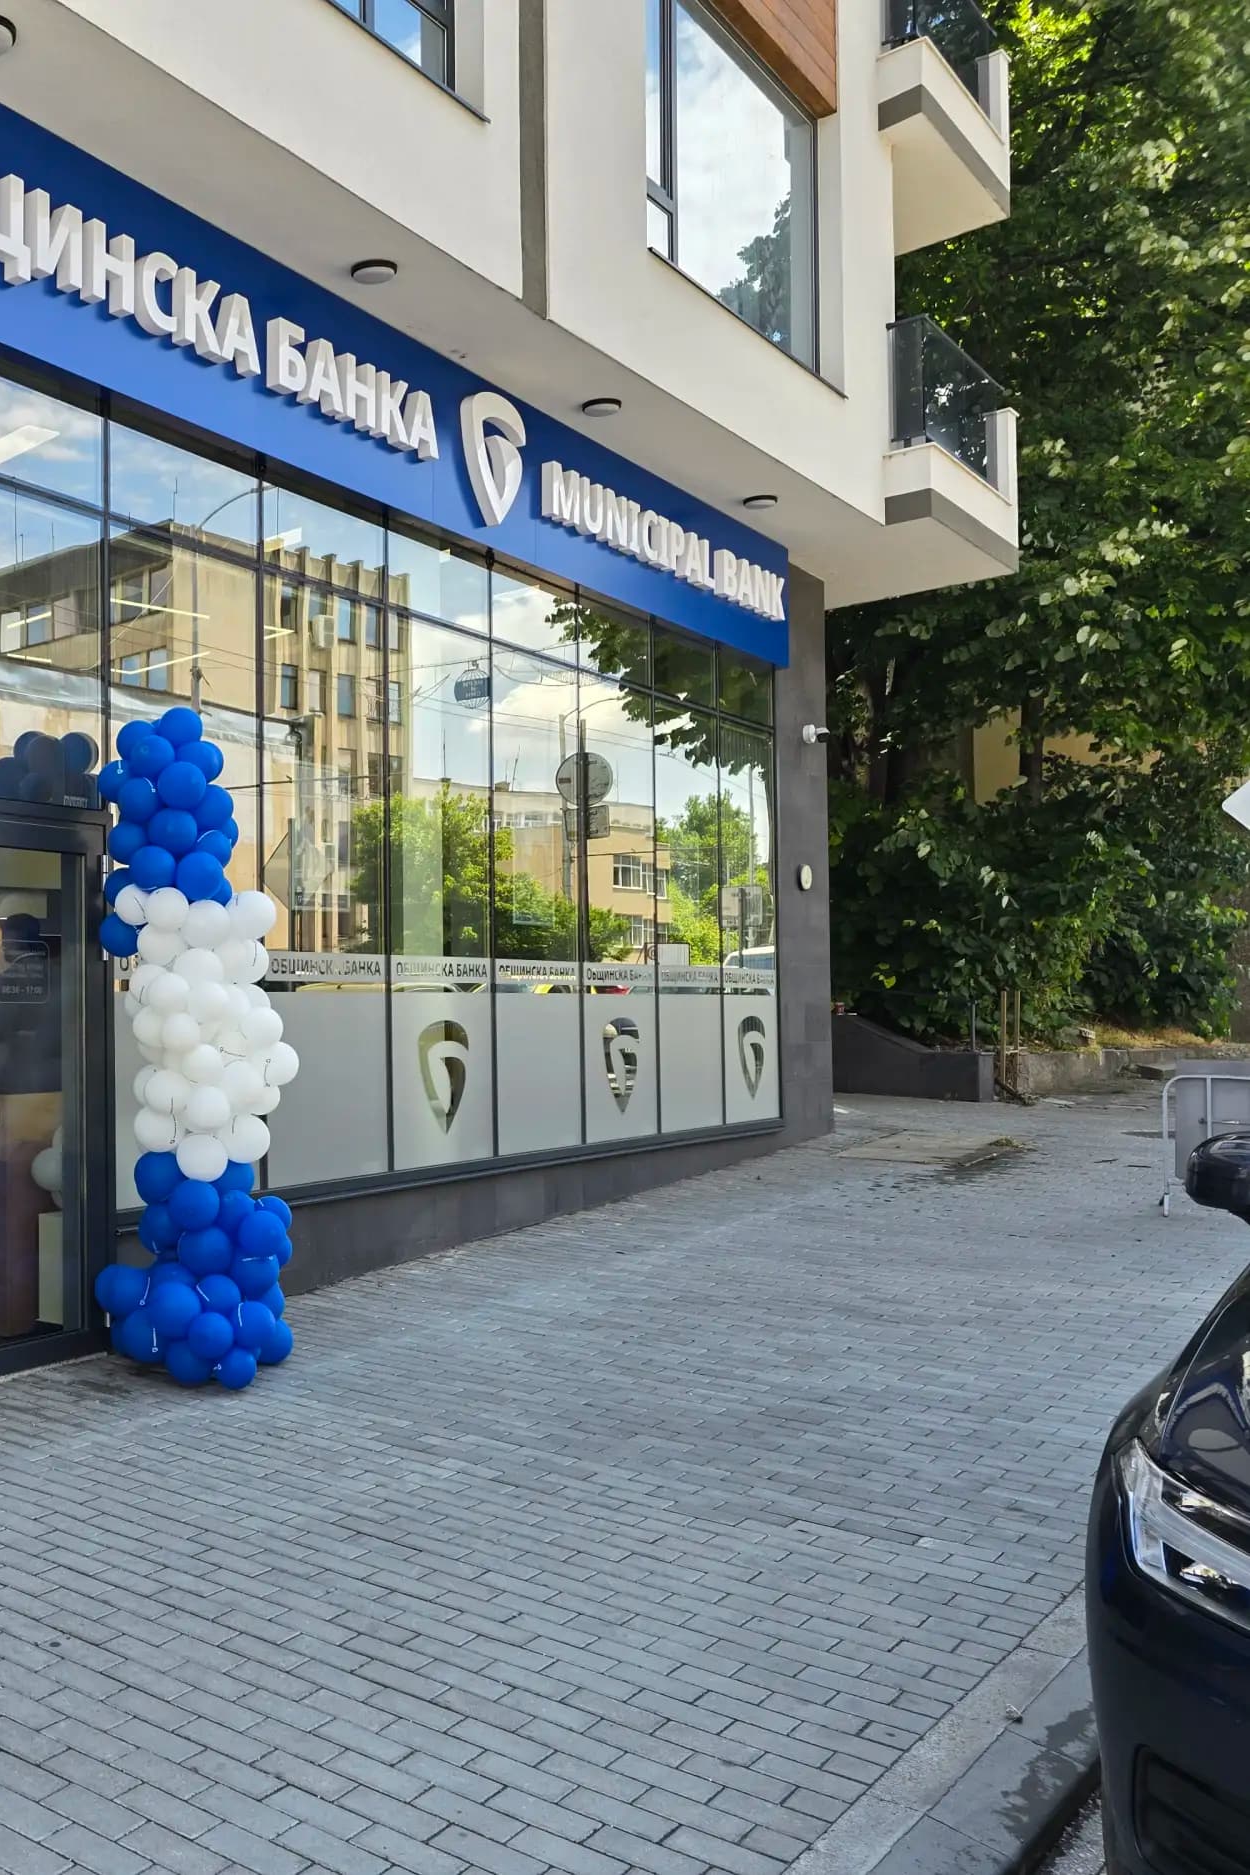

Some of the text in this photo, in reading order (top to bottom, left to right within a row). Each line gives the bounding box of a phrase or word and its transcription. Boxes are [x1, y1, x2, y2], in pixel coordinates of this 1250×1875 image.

[265, 315, 440, 462] БАНКА
[540, 460, 787, 622] MUNICIPAL BANK
[271, 957, 382, 977] ОБЩИНСК БАНКА
[456, 962, 488, 978] БАНКА
